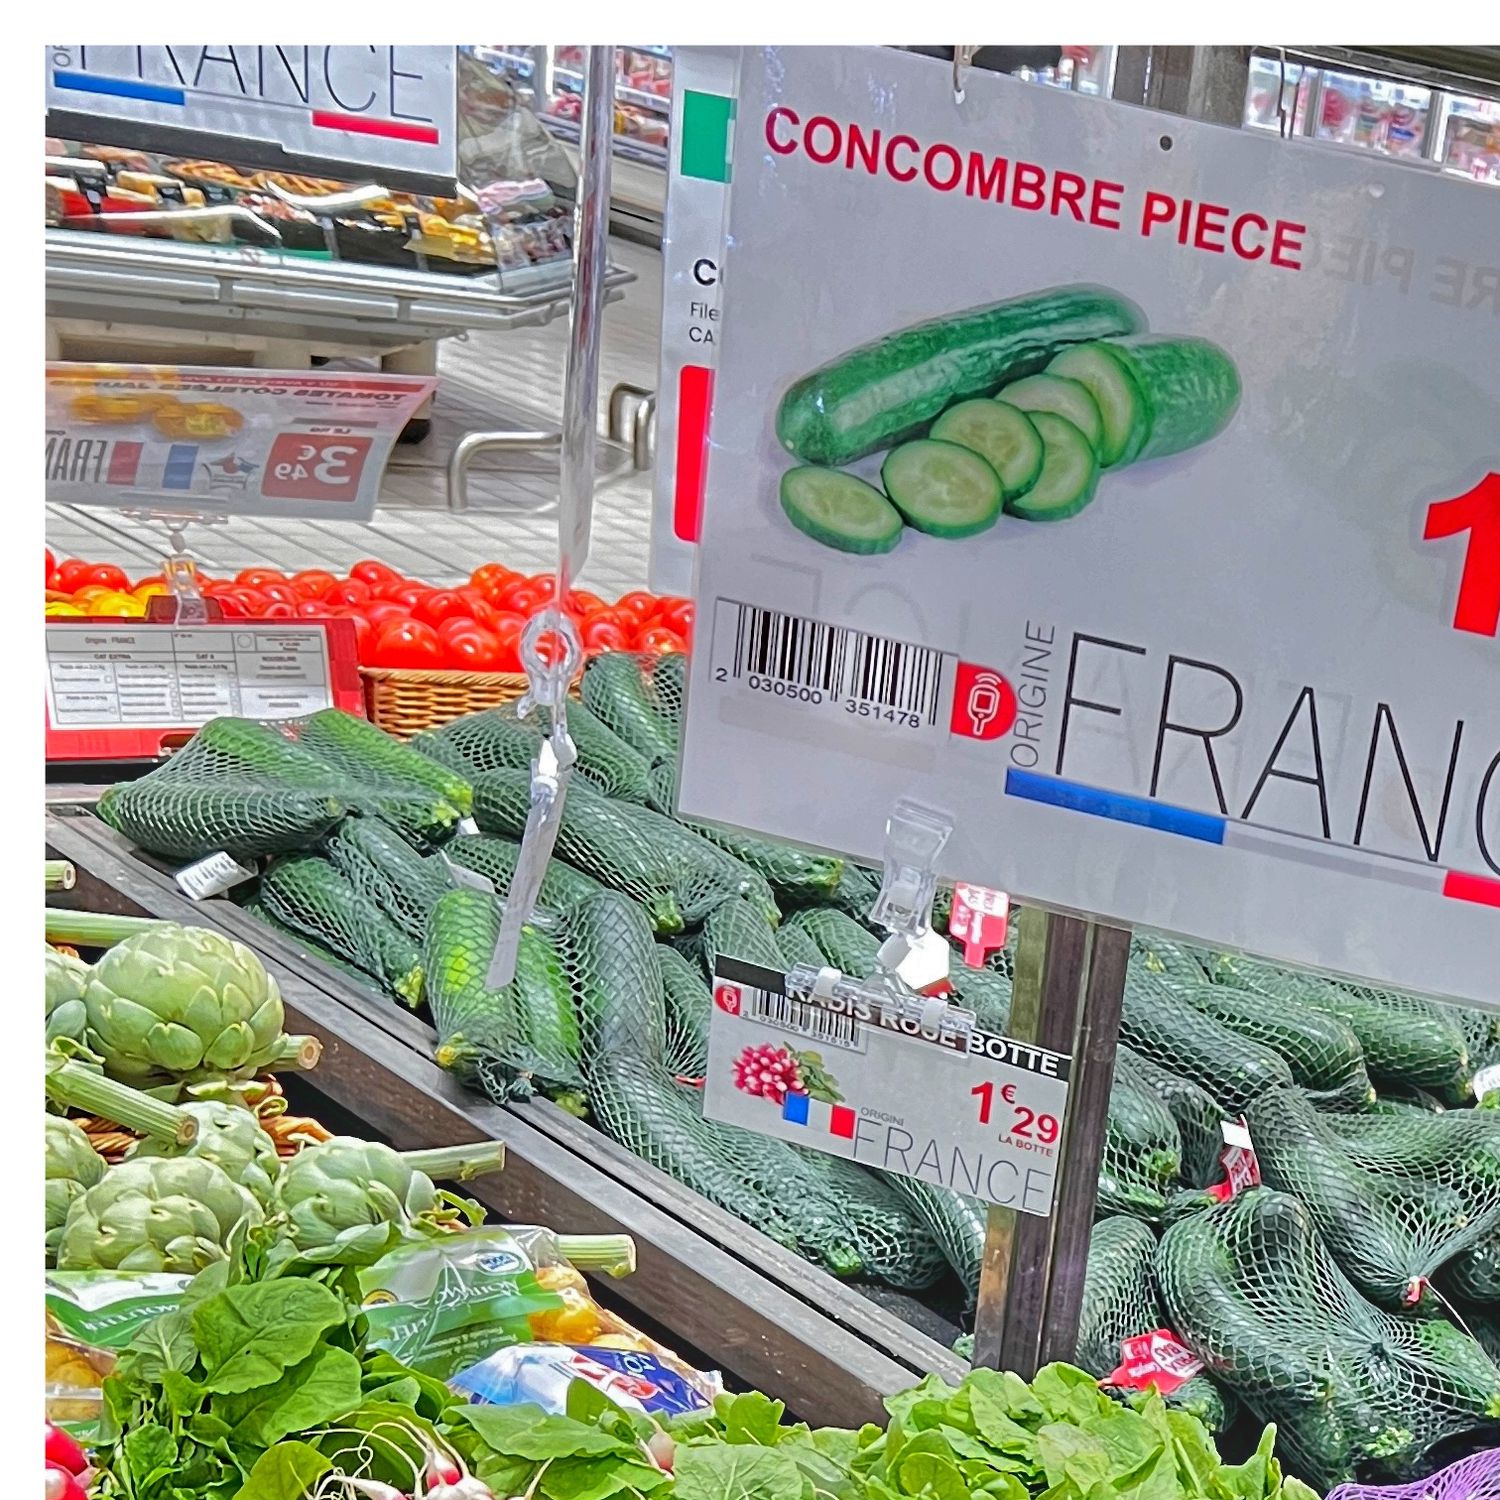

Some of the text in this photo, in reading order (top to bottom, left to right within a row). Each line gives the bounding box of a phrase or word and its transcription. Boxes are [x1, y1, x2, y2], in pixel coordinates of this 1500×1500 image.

[80, 45, 434, 123] ANCE
[765, 106, 1307, 271] CONCOMBRE PIECE
[715, 667, 920, 729] 2 030500 351478
[1010, 620, 1056, 768] ORIGINE
[969, 1028, 1060, 1078] BOTTE
[971, 1080, 994, 1125] 1
[1010, 1106, 1060, 1146] 29
[998, 1132, 1054, 1158] LA BOTTE
[853, 1117, 1053, 1214] FRANCE
